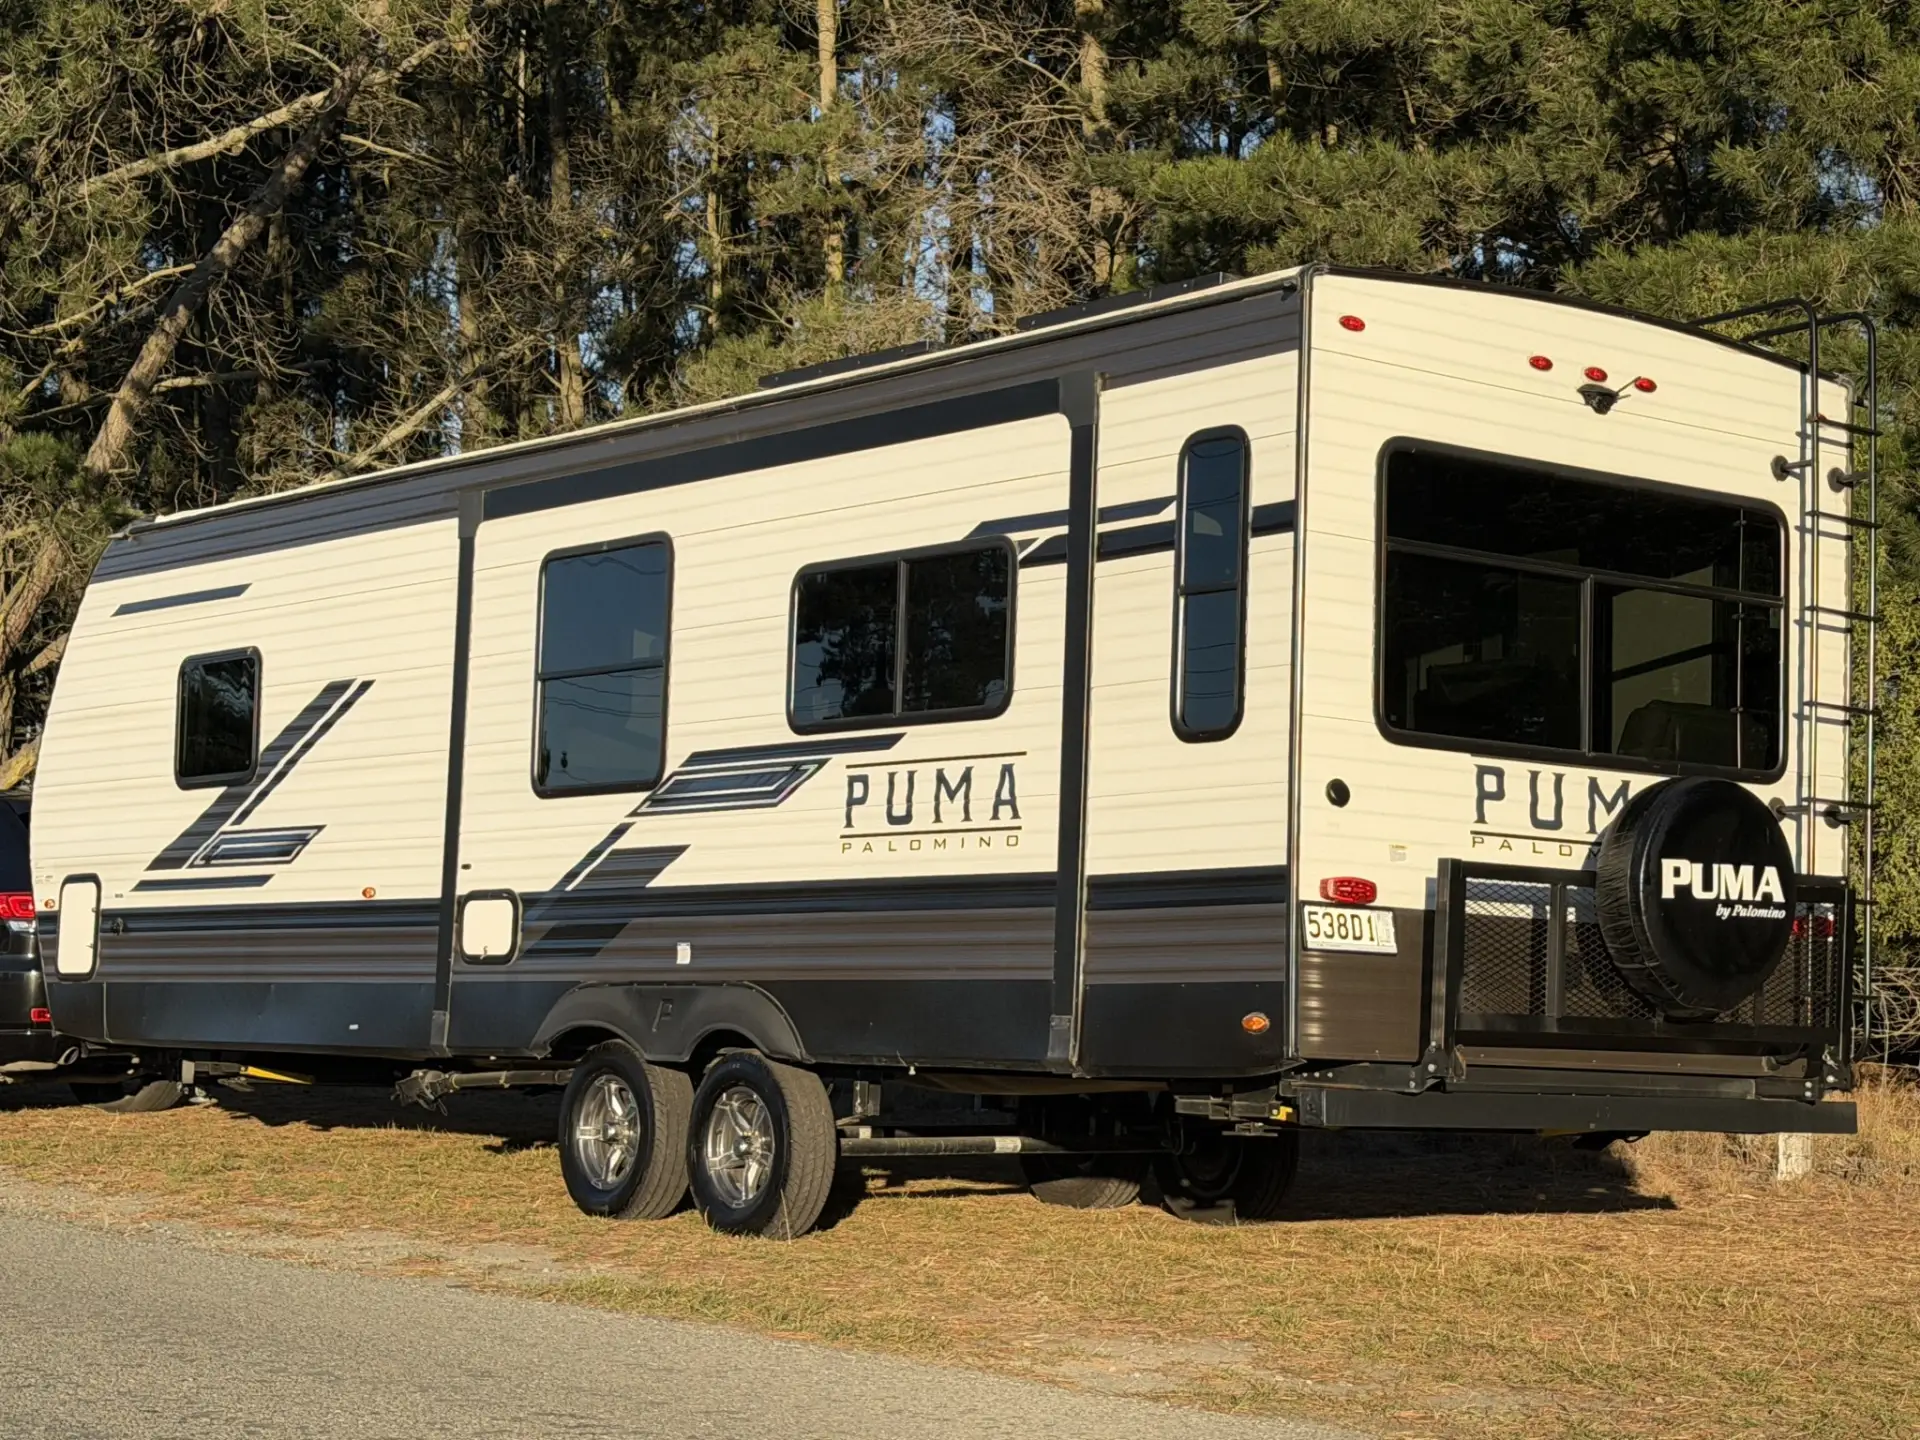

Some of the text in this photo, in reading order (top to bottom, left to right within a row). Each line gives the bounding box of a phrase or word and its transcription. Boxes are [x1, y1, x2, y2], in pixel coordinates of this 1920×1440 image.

[843, 763, 1022, 828] PUMA
[1473, 764, 1631, 834] PUM
[841, 835, 1019, 853] PALOMINO
[1661, 858, 1785, 902] PUMA
[1308, 911, 1374, 942] 538D1
[1716, 903, 1786, 919] by Palomino
